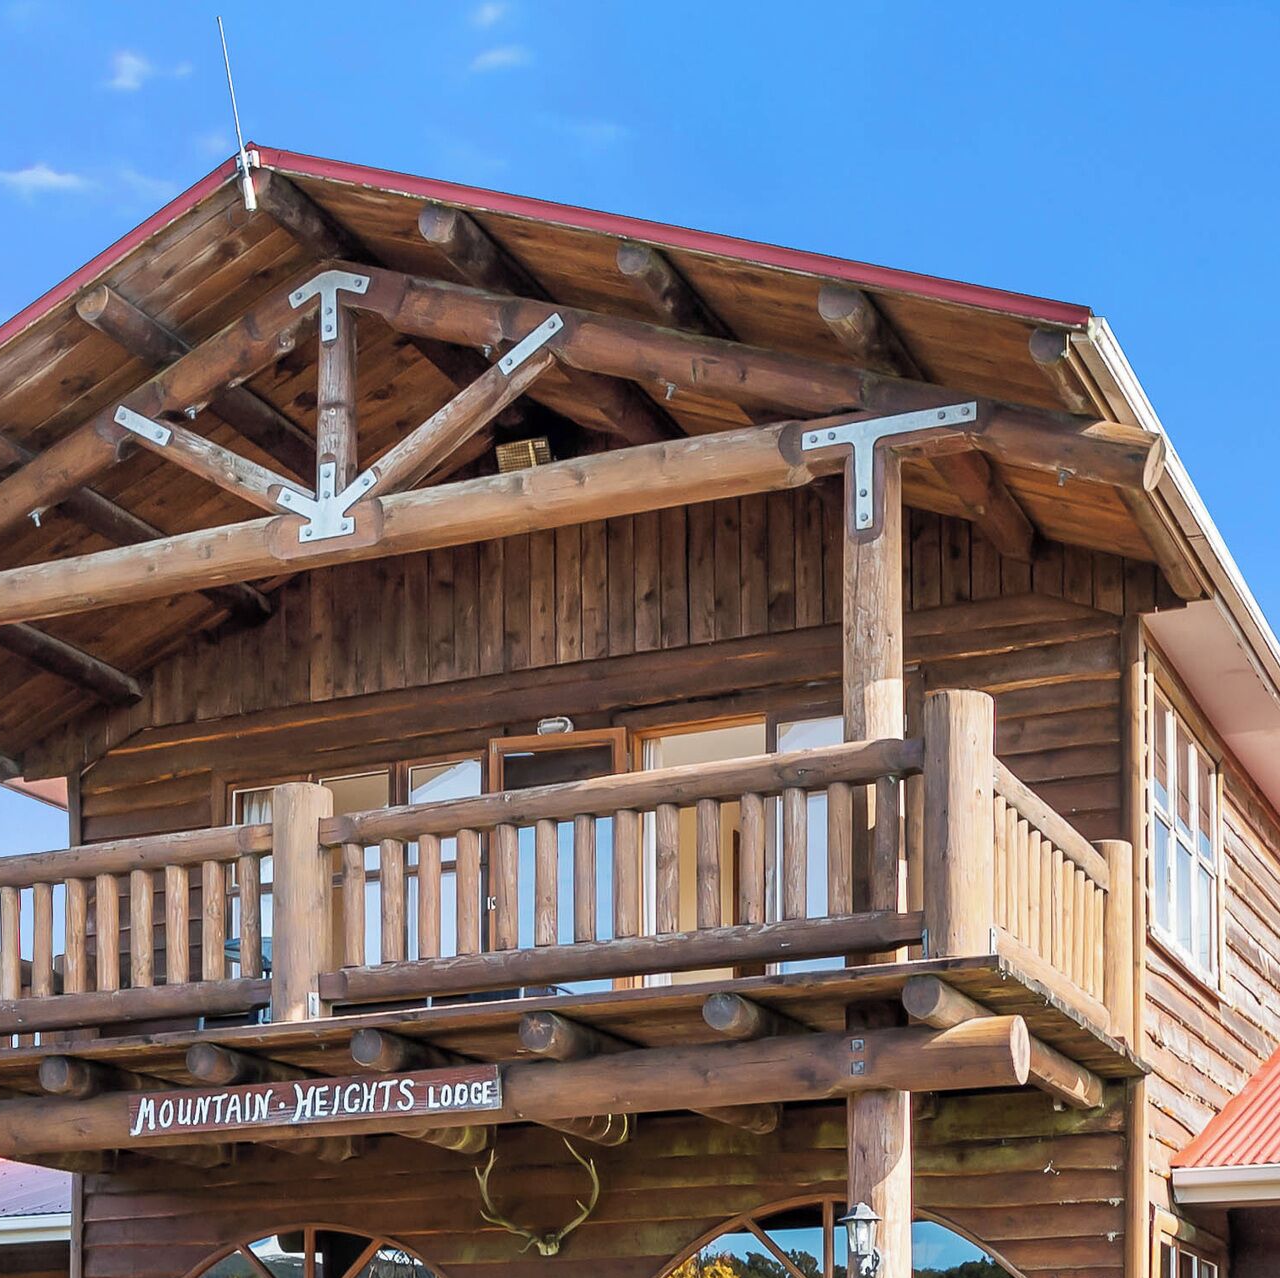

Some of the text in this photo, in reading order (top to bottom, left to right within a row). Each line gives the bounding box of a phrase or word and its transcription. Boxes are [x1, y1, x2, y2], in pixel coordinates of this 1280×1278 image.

[130, 1079, 493, 1136] MOUNTAIN HEIGHTS LODGE
